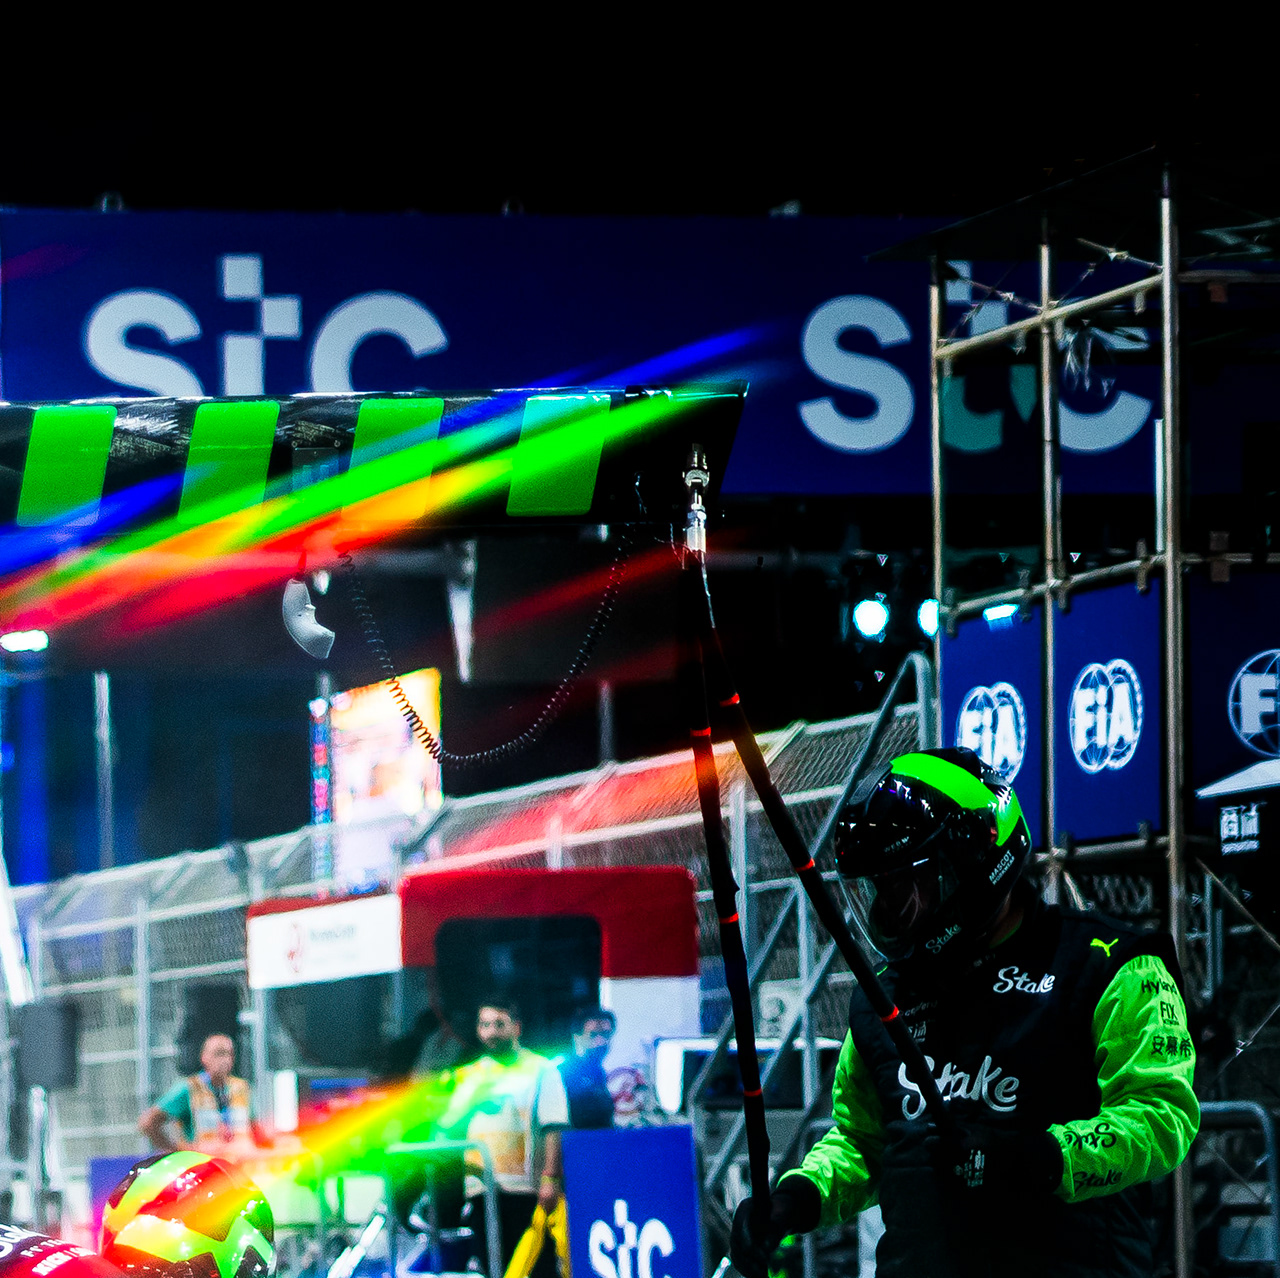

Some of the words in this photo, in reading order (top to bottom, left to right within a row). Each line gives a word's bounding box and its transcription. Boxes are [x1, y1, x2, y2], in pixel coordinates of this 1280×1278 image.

[988, 850, 1014, 883] MASCOT
[924, 923, 963, 955] Stake
[992, 965, 1057, 994] Stake
[1159, 1000, 1179, 1021] FIX
